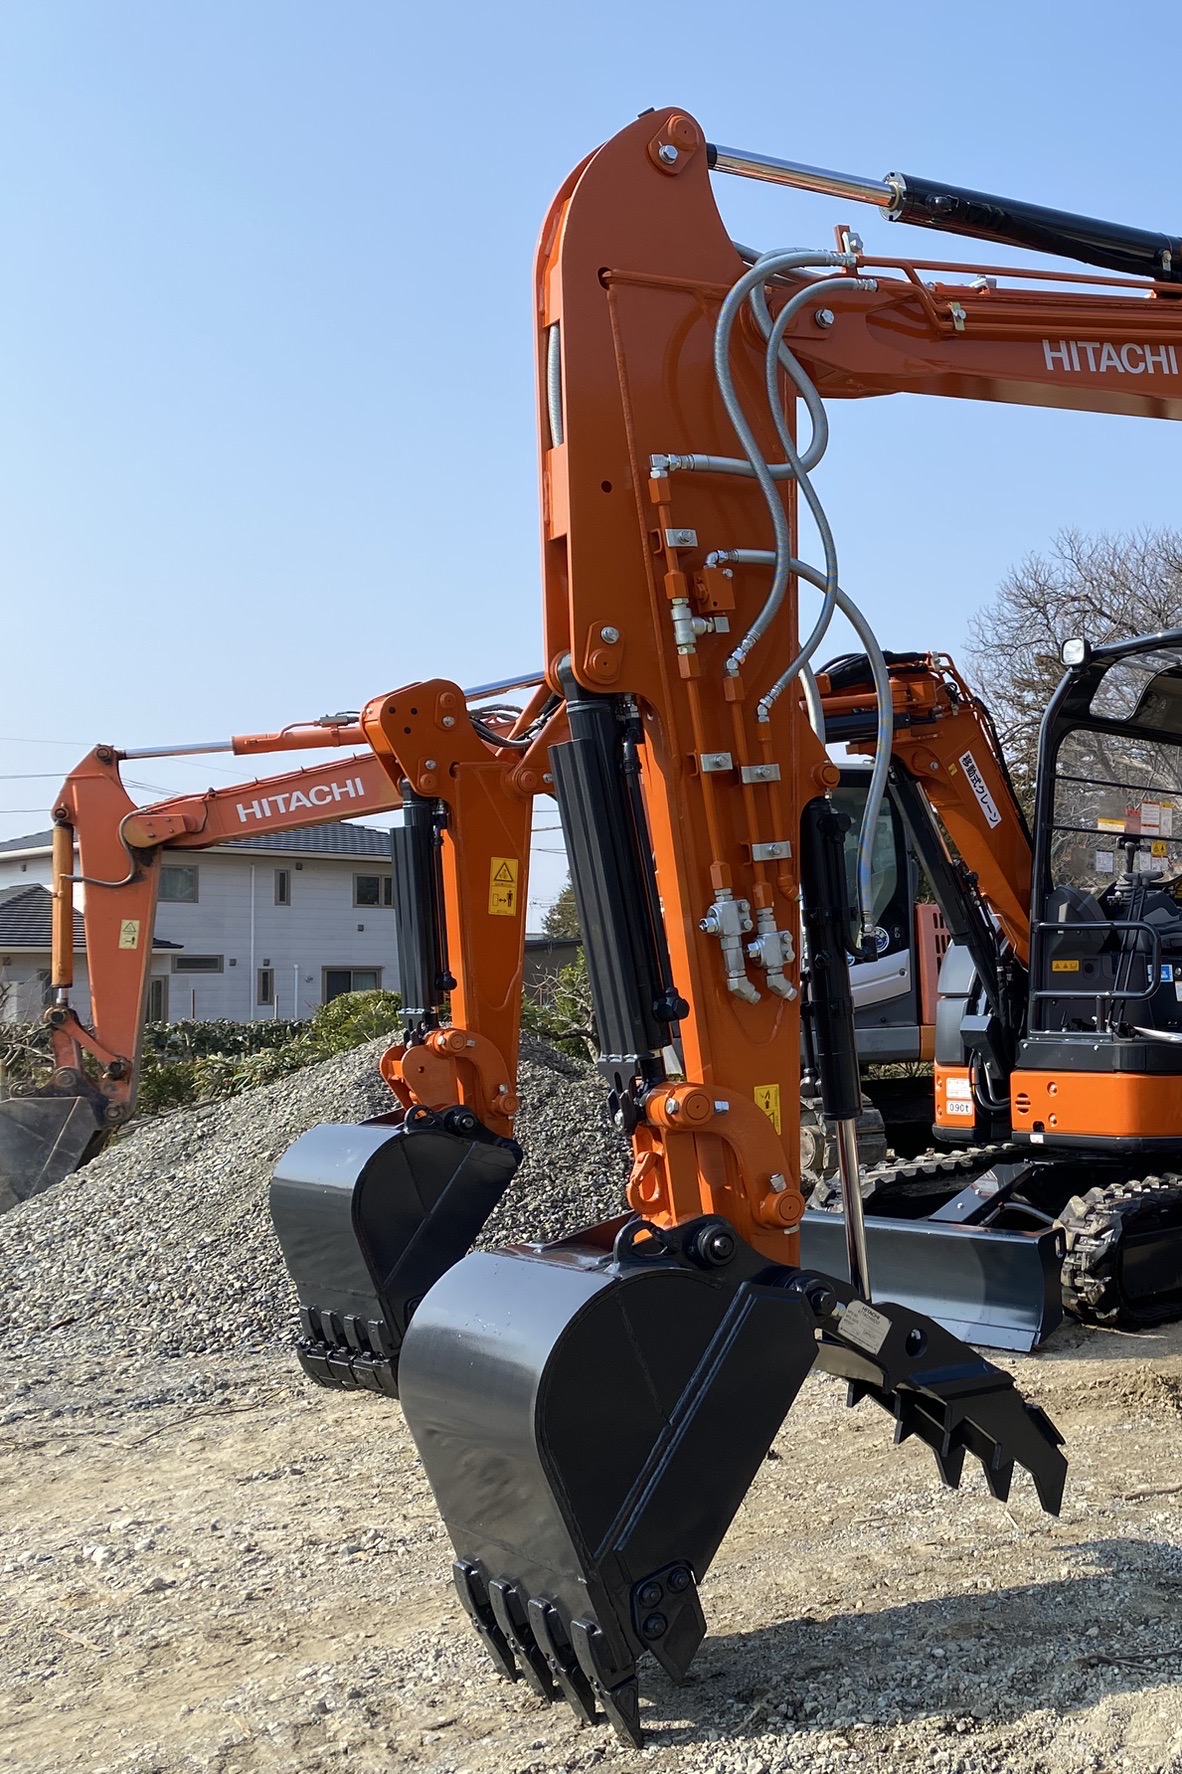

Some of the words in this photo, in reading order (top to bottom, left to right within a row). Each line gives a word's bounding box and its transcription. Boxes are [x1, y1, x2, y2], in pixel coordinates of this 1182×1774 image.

[1041, 339, 1179, 375] HITACHI
[236, 777, 365, 823] HITACHI
[961, 754, 999, 823] 移動式クレーン
[861, 1306, 880, 1320] HITACHI
